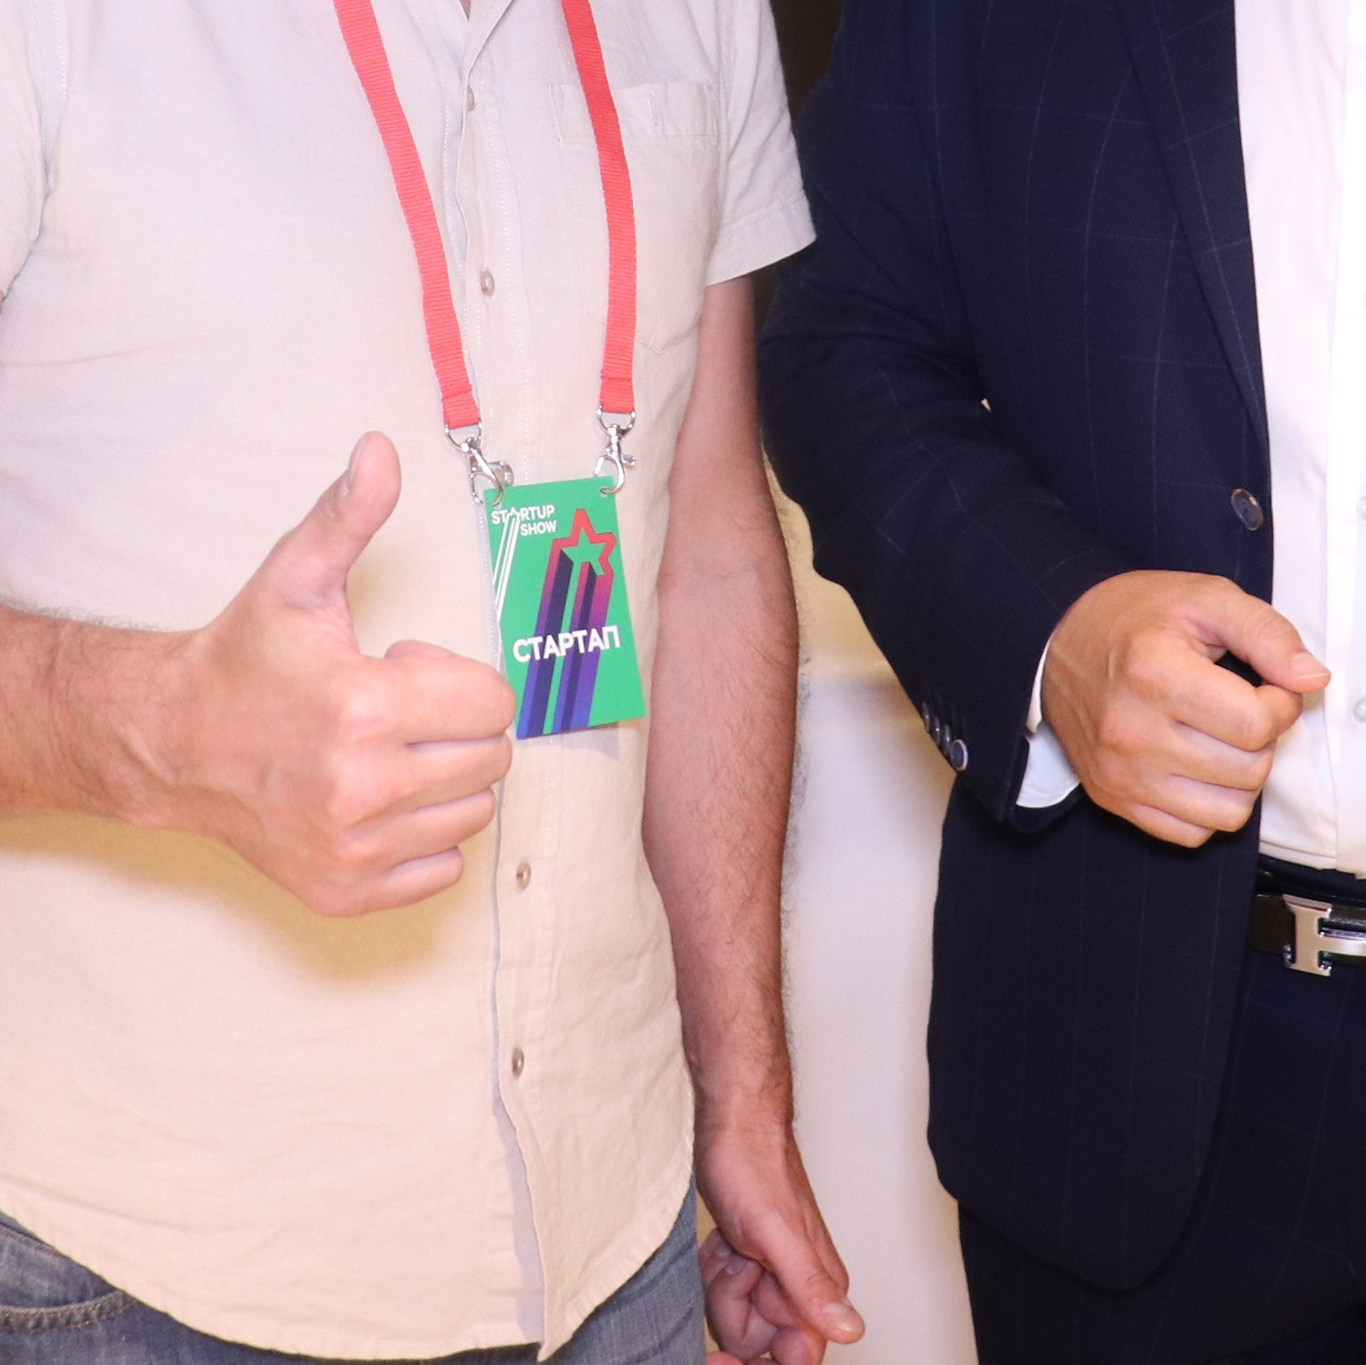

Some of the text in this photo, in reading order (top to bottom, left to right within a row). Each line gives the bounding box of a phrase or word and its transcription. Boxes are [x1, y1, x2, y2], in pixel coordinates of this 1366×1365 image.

[491, 504, 555, 525] STARTUP
[520, 519, 557, 536] SHOW
[512, 625, 621, 663] СТАРТАП
